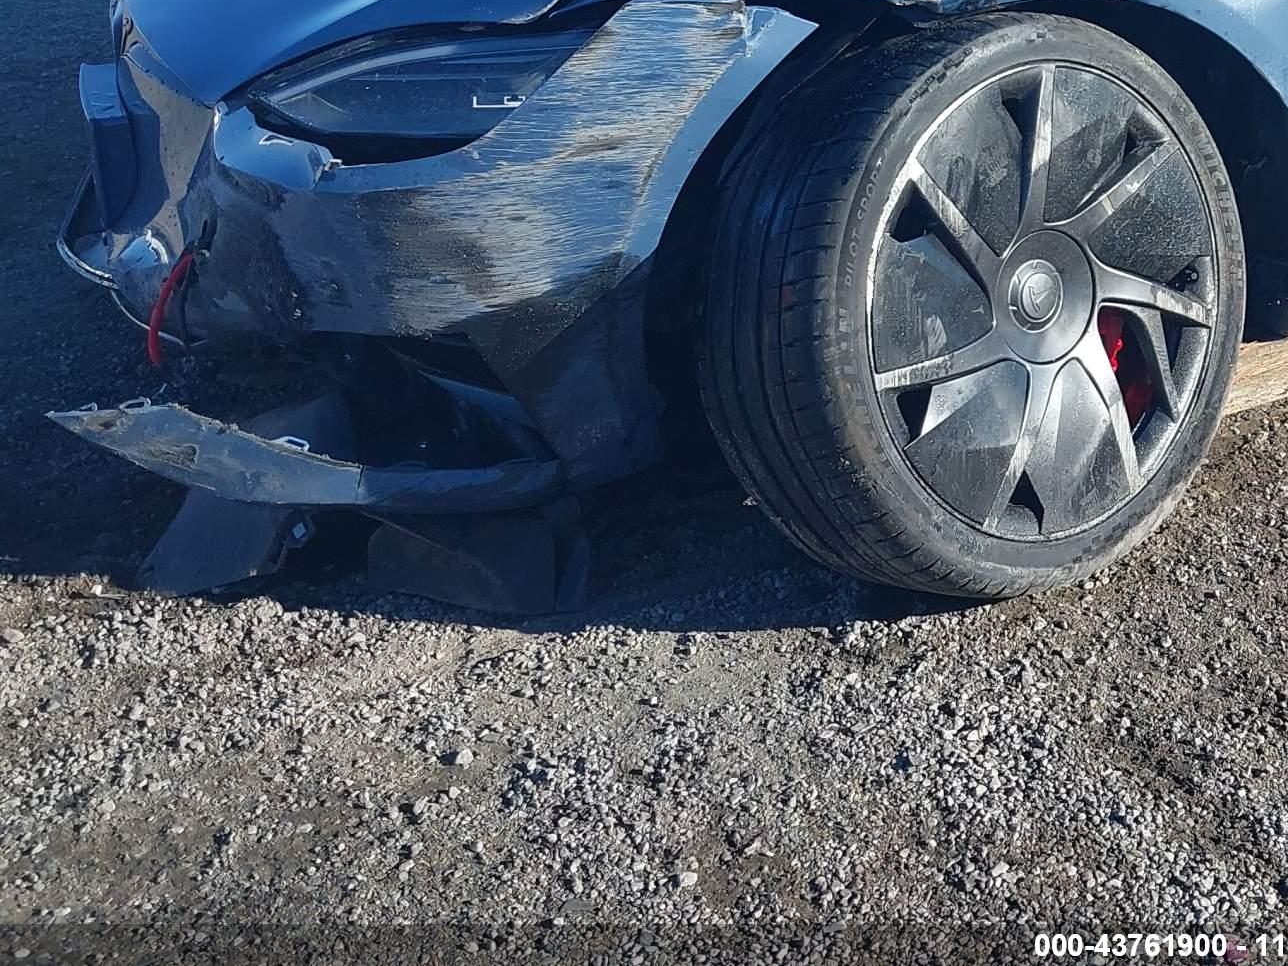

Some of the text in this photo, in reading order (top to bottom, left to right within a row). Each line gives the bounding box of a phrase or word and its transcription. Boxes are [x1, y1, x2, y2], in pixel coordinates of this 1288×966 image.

[844, 227, 862, 287] PILOT
[857, 156, 883, 221] SPORT
[1197, 133, 1243, 283] MICHELIN
